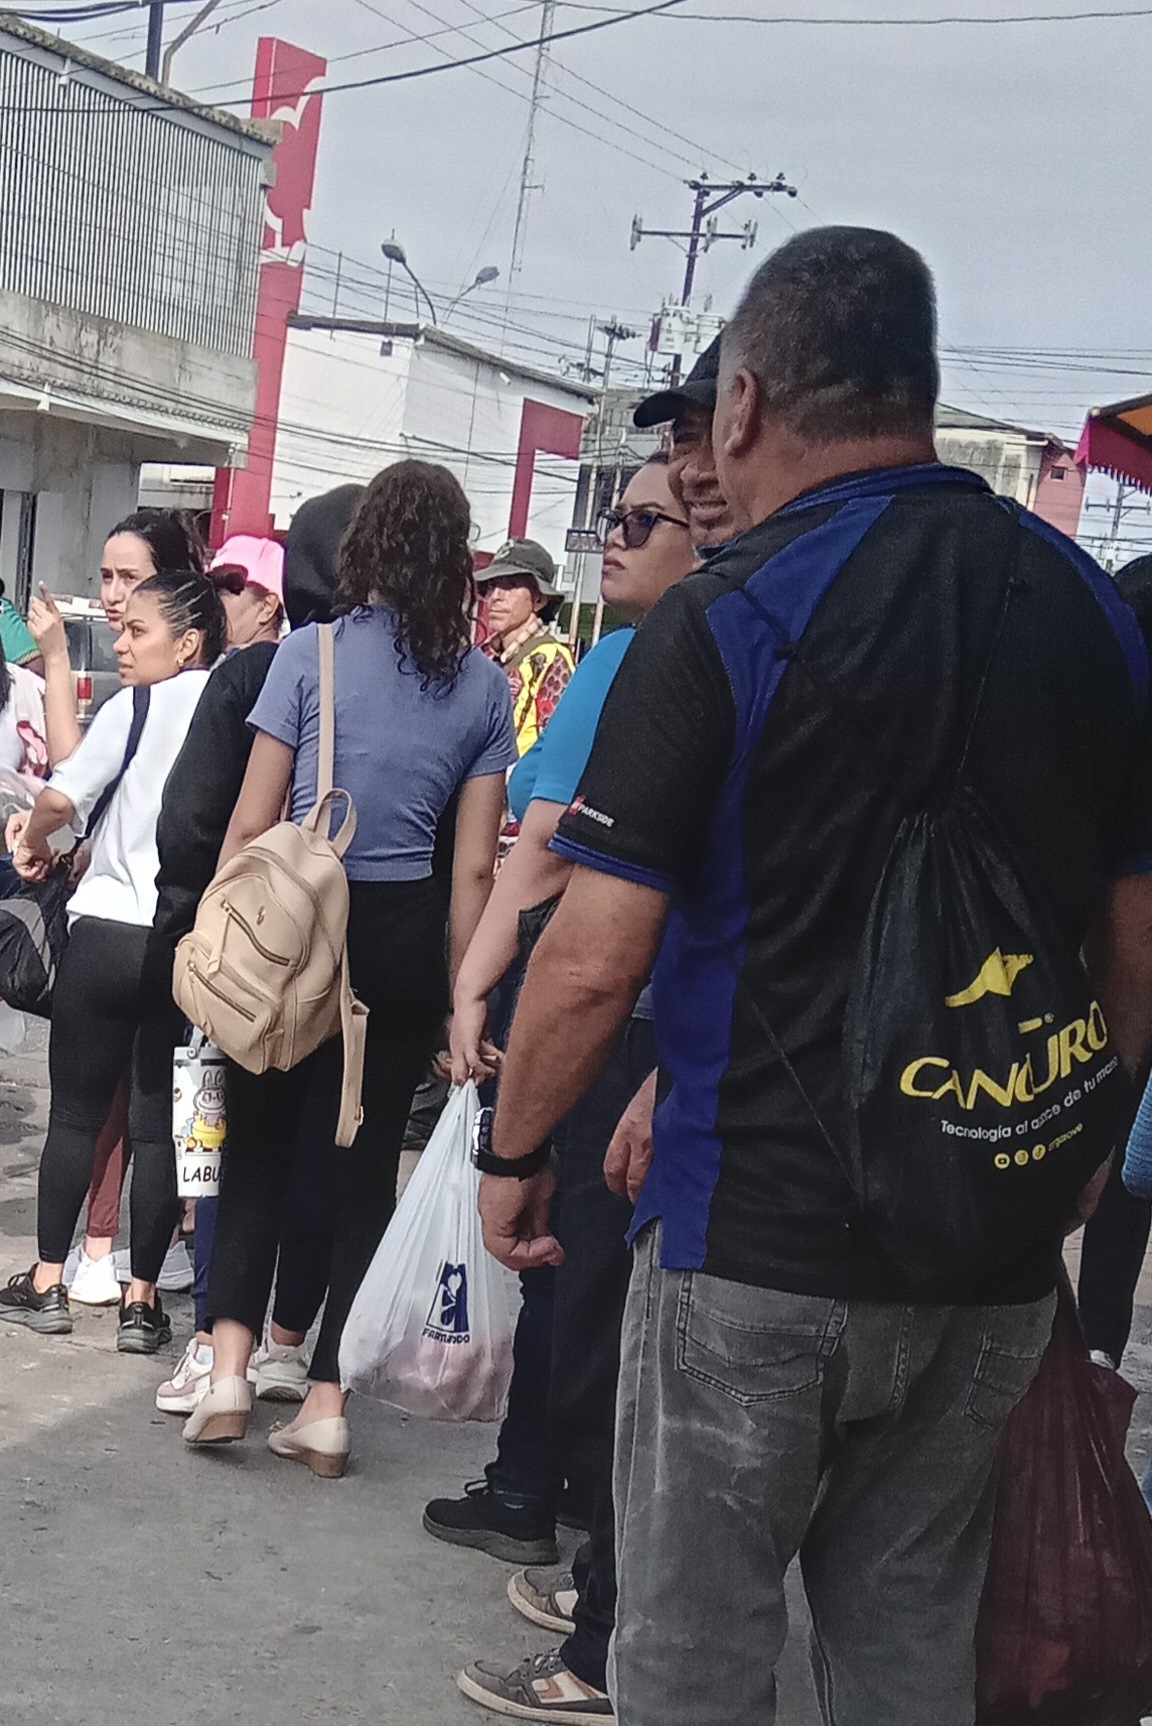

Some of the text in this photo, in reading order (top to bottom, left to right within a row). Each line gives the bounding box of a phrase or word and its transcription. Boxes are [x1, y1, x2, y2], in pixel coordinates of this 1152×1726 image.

[940, 1120, 1012, 1143] Tecnología
[1015, 1120, 1028, 1135] al
[1063, 1089, 1082, 1108] de
[1083, 1077, 1096, 1093] tu
